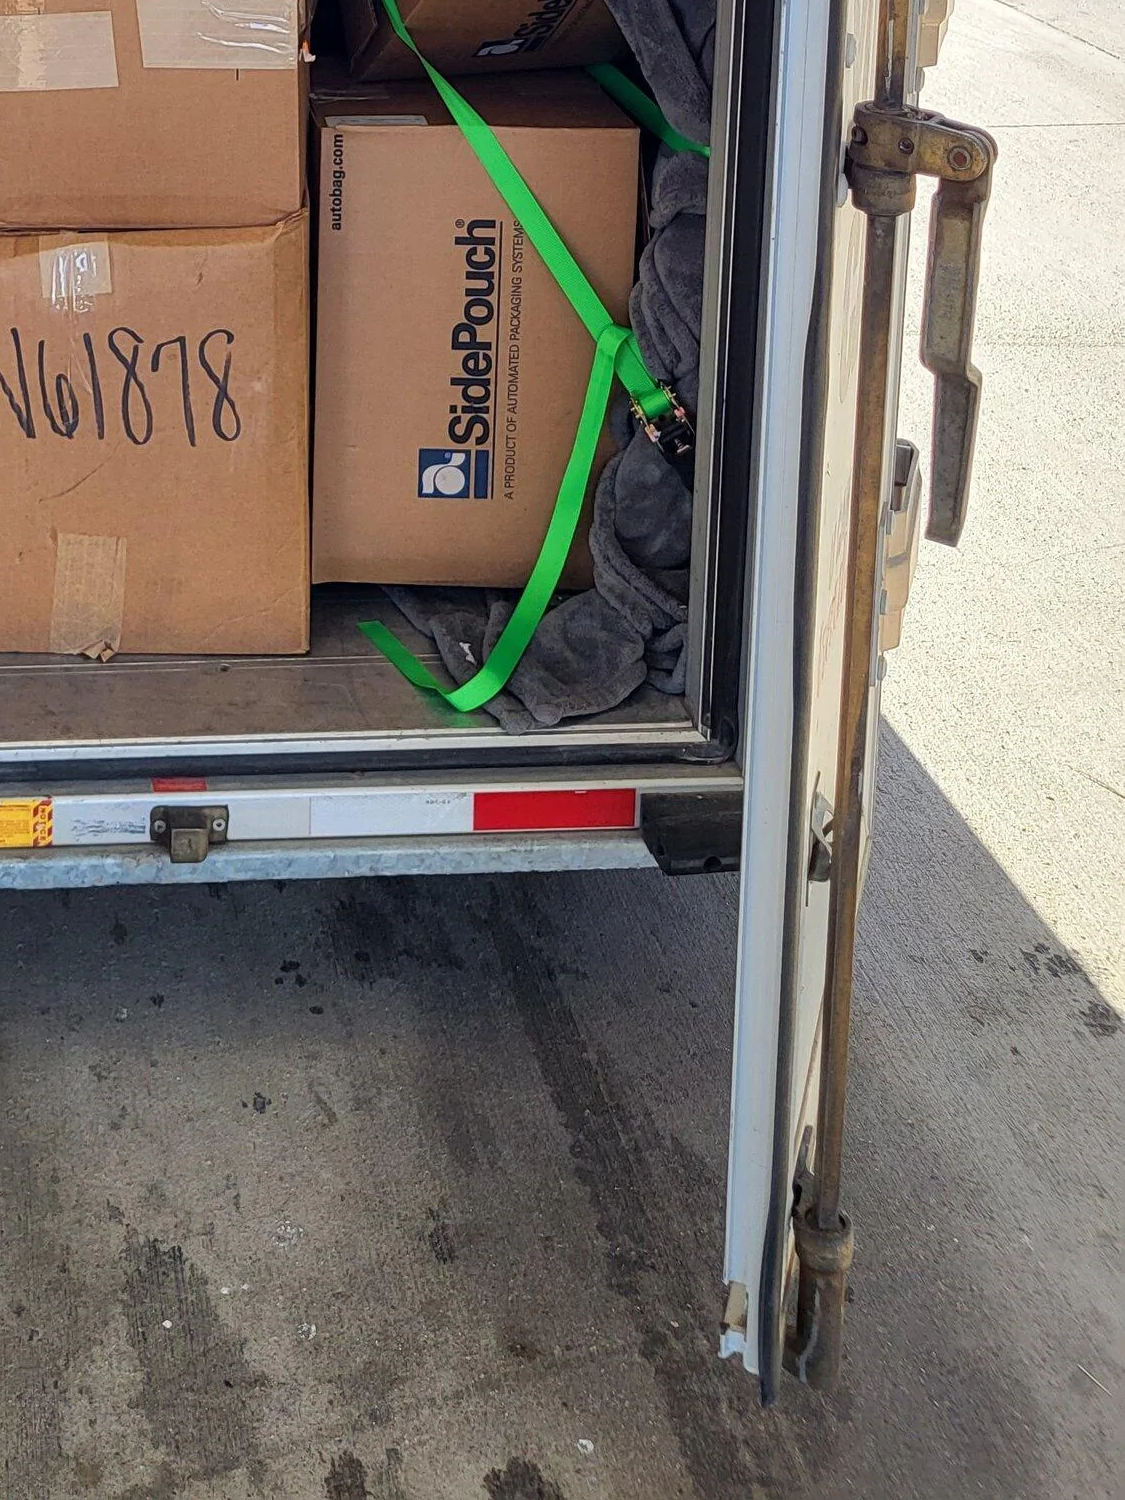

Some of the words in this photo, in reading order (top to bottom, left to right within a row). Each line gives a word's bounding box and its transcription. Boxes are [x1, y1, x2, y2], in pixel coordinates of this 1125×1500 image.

[329, 132, 346, 231] autobag.com
[512, 220, 524, 273] SYSTEMS
[510, 277, 522, 341] PACKAGING
[508, 344, 520, 414] AUTOMATED
[506, 416, 517, 432] OF
[505, 434, 517, 489] PRODUCT
[504, 491, 514, 500] A
